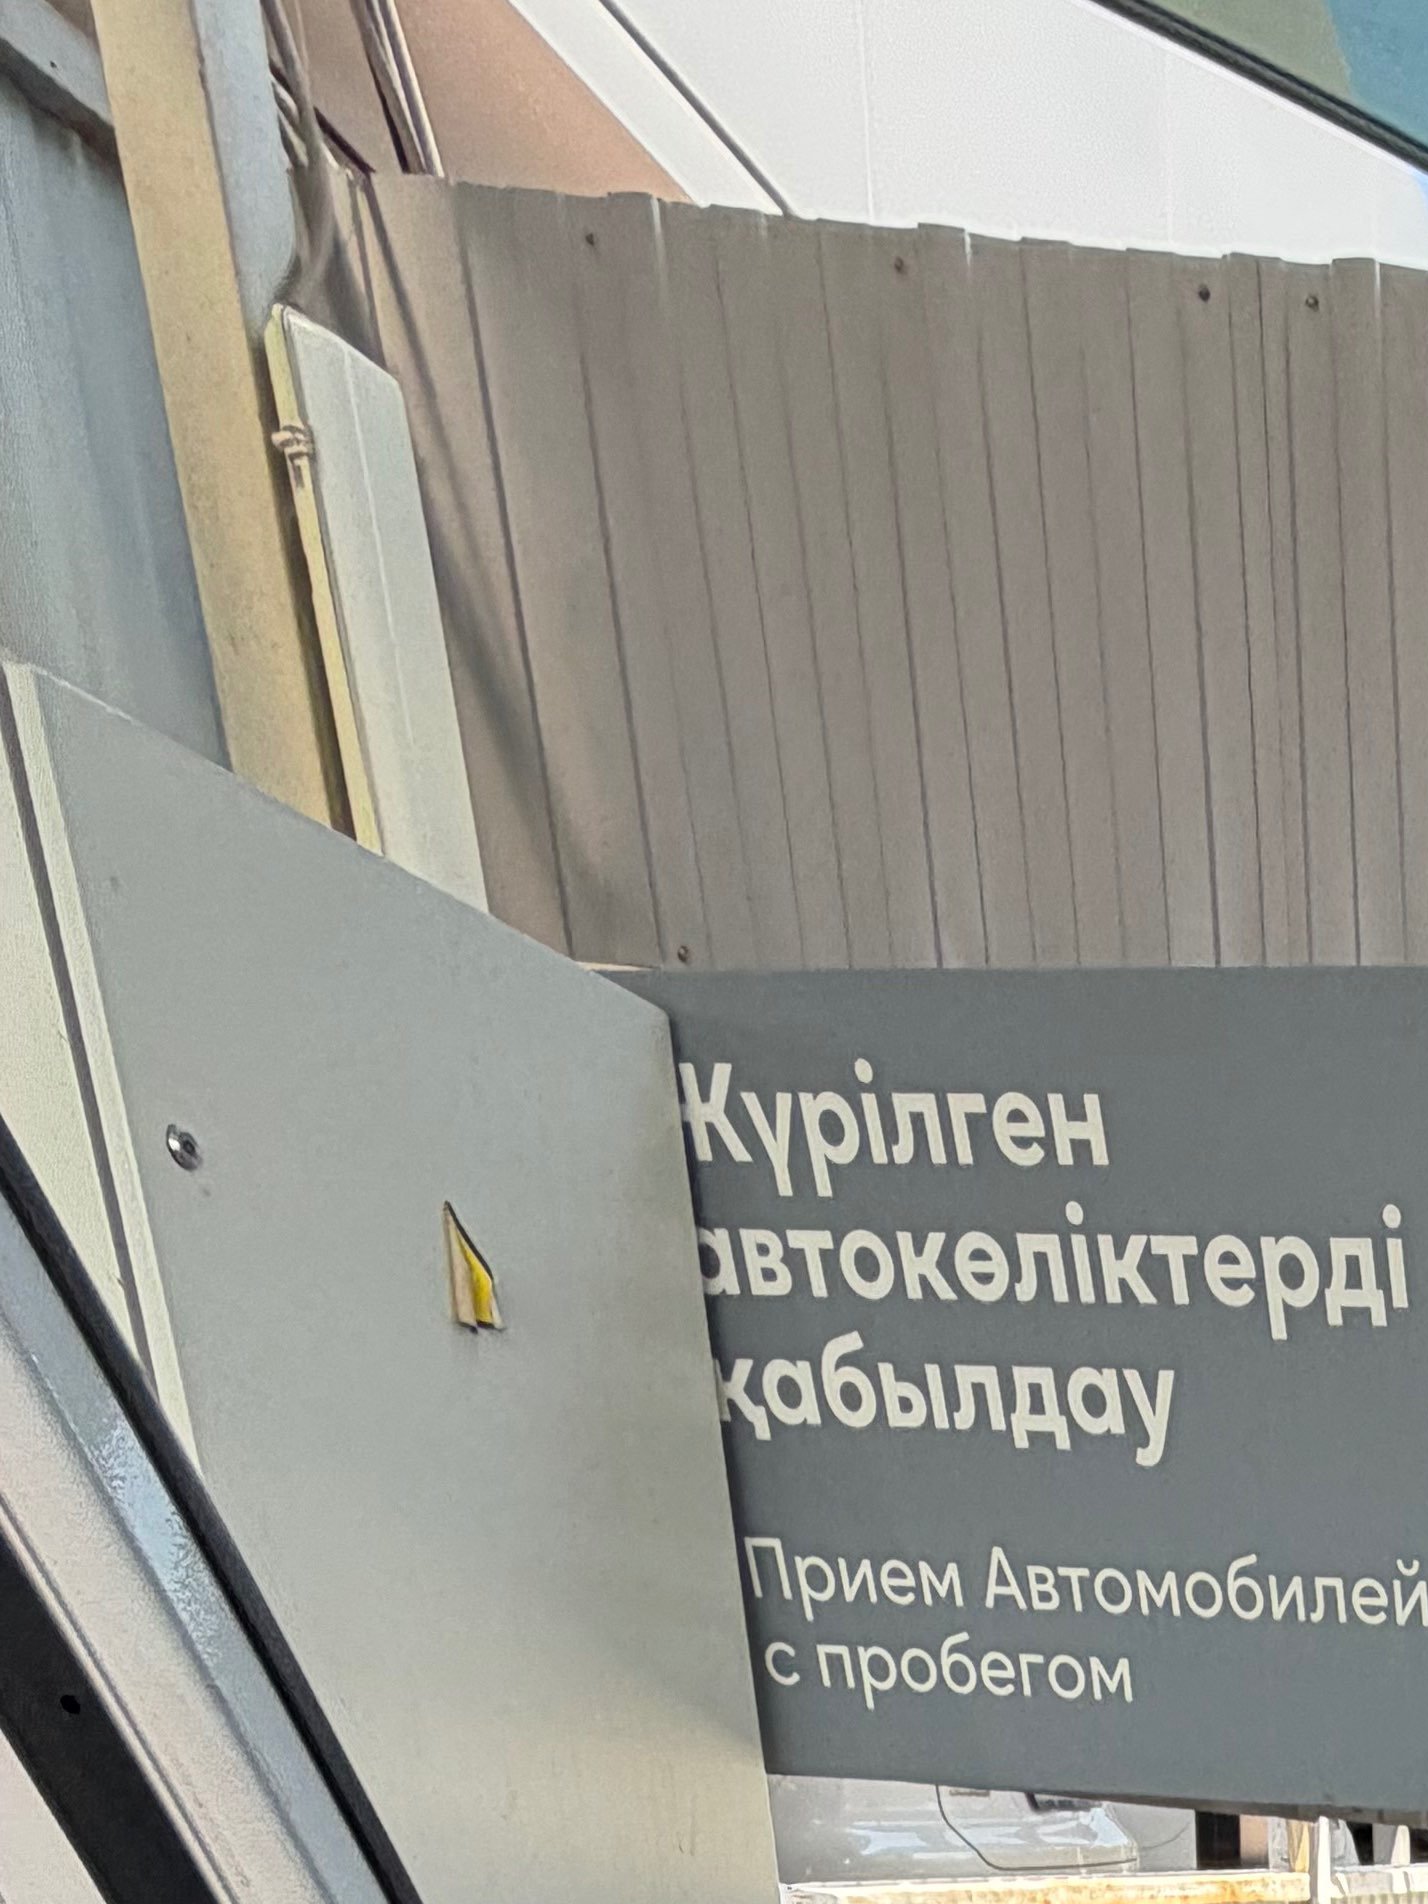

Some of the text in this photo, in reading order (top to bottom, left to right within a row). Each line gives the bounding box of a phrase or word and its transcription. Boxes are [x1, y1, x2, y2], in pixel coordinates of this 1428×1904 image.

[697, 1200, 1410, 1342] автокөліктерді
[714, 1329, 1176, 1468] қабылдау
[744, 1536, 964, 1623] Прием
[764, 1630, 1135, 1711] с пробегом
